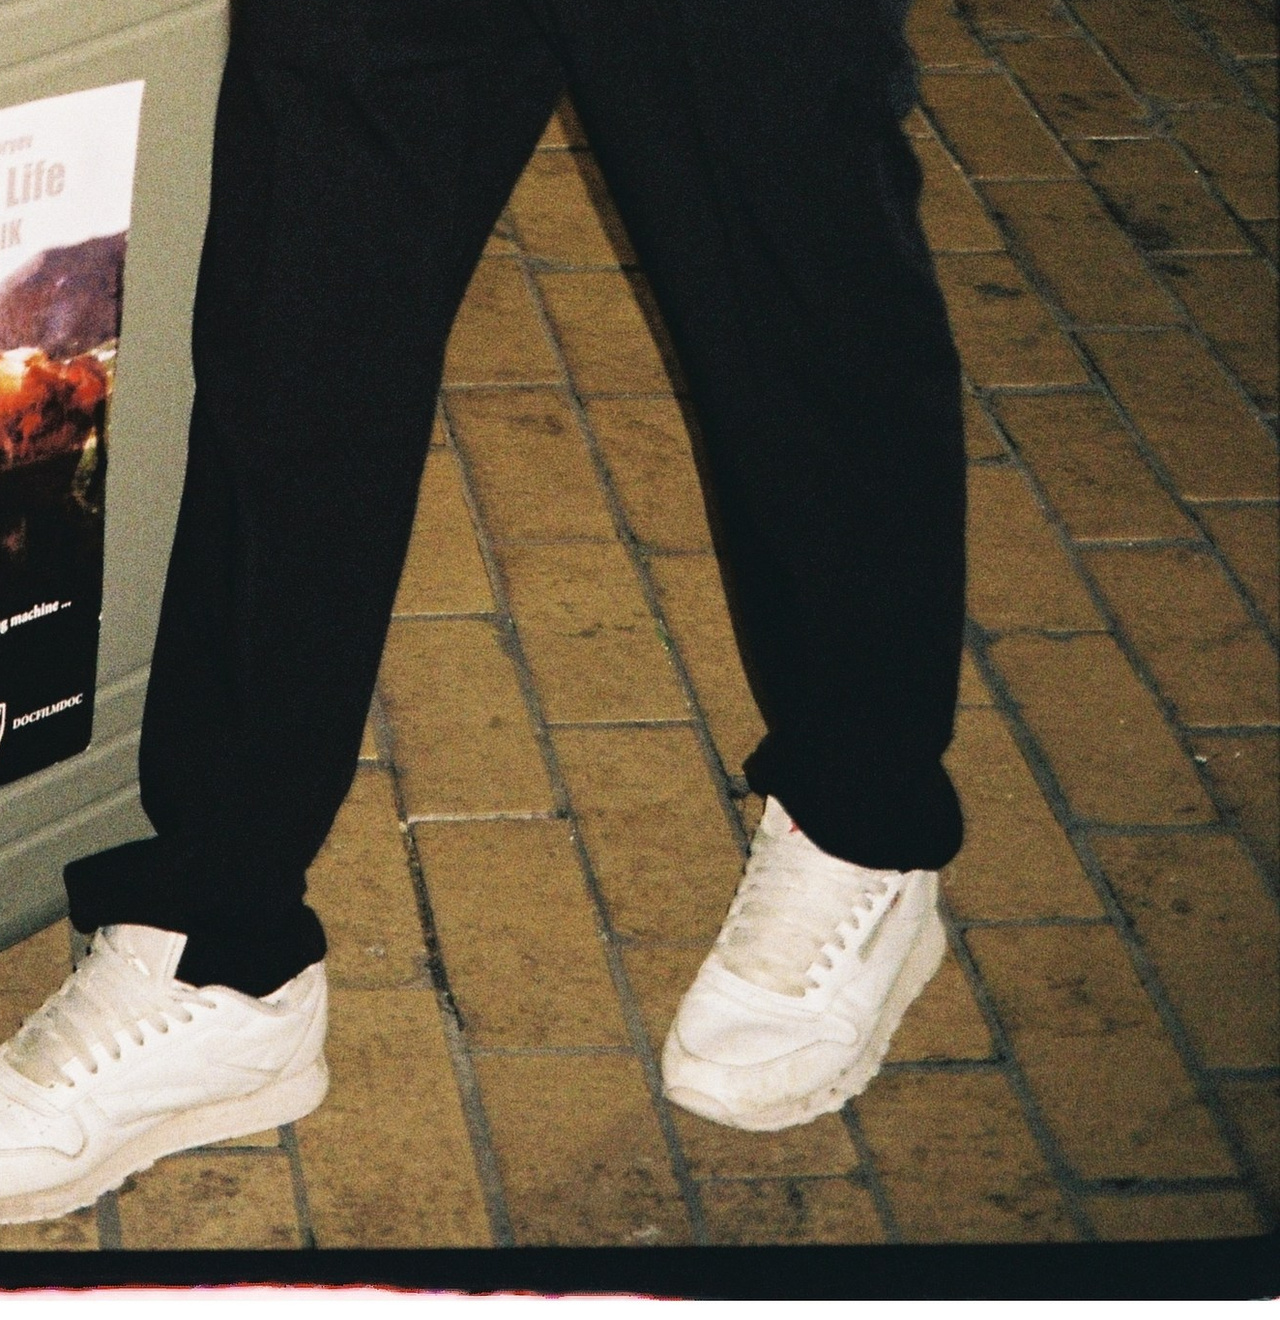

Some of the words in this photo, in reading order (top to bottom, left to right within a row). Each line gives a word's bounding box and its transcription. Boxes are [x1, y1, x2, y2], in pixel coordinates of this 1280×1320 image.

[6, 159, 67, 208] Life
[10, 600, 60, 627] machine
[12, 692, 84, 730] DOCFILMDOC
